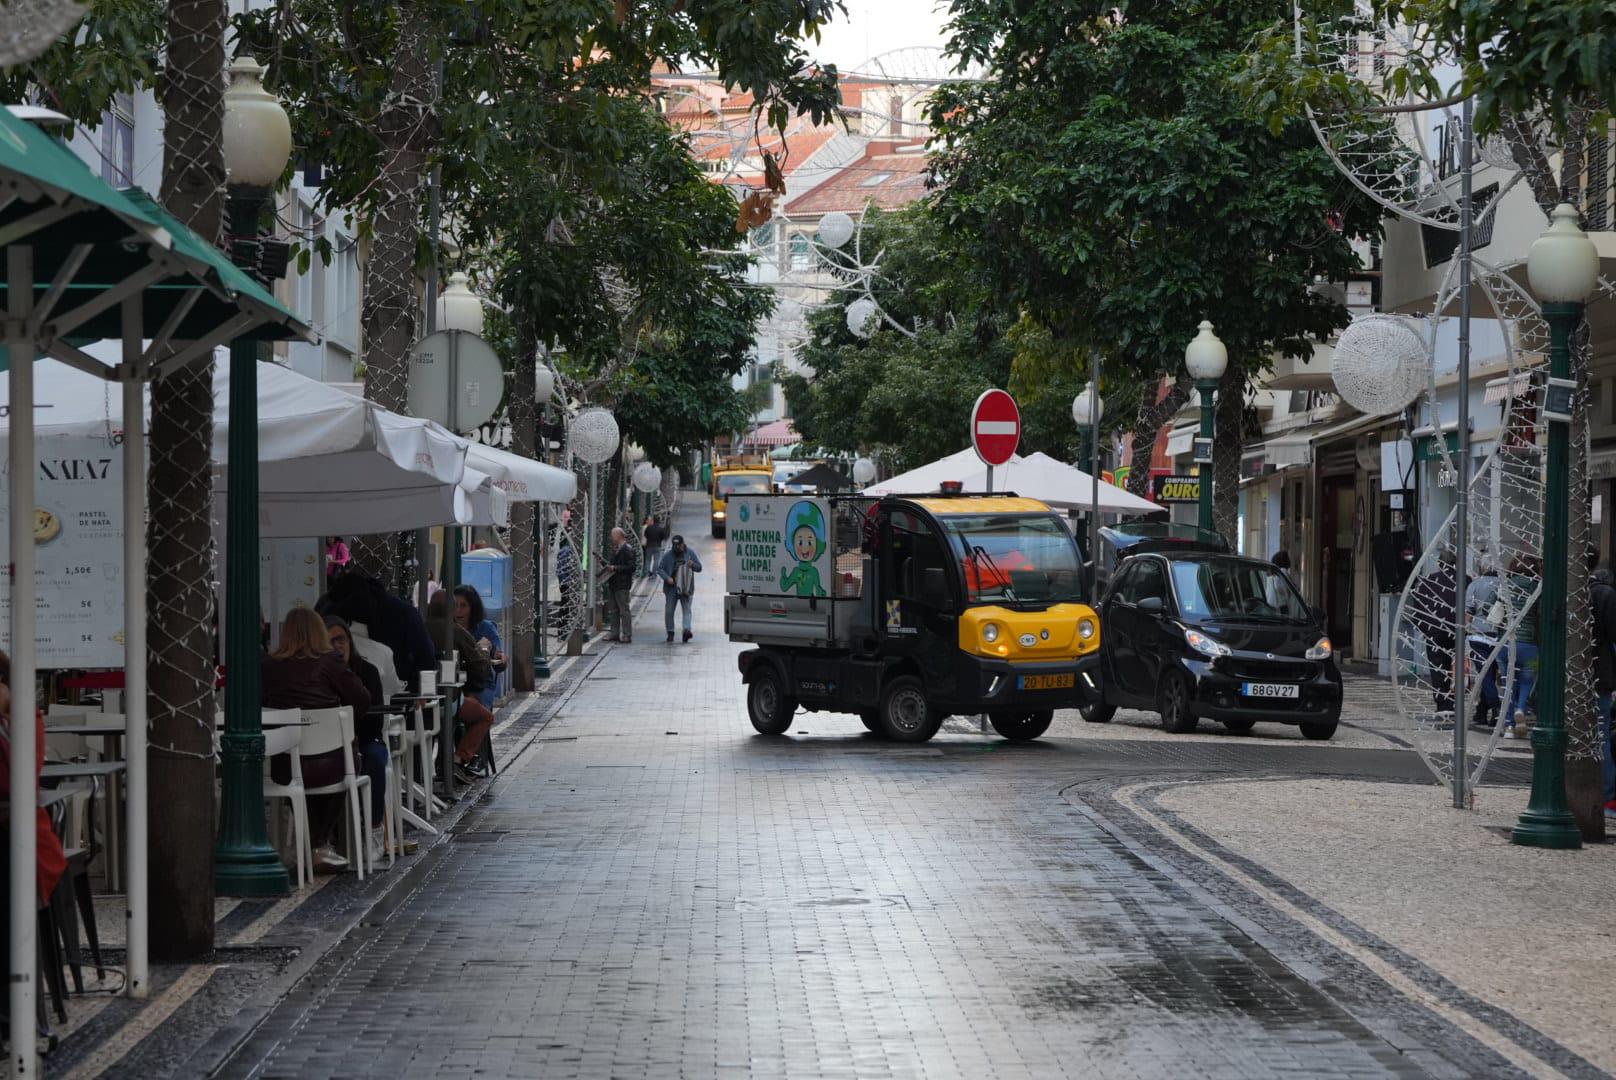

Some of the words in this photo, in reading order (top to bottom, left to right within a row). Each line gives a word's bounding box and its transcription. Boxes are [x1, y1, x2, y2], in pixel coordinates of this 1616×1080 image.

[1162, 484, 1200, 498] OURO
[731, 529, 781, 543] MANTENHA
[736, 543, 743, 557] A
[745, 544, 776, 558] CIDADE
[65, 566, 92, 575] 1,50€
[741, 558, 771, 573] LIMPA!
[81, 600, 92, 608] 5€
[81, 634, 93, 642] 5€
